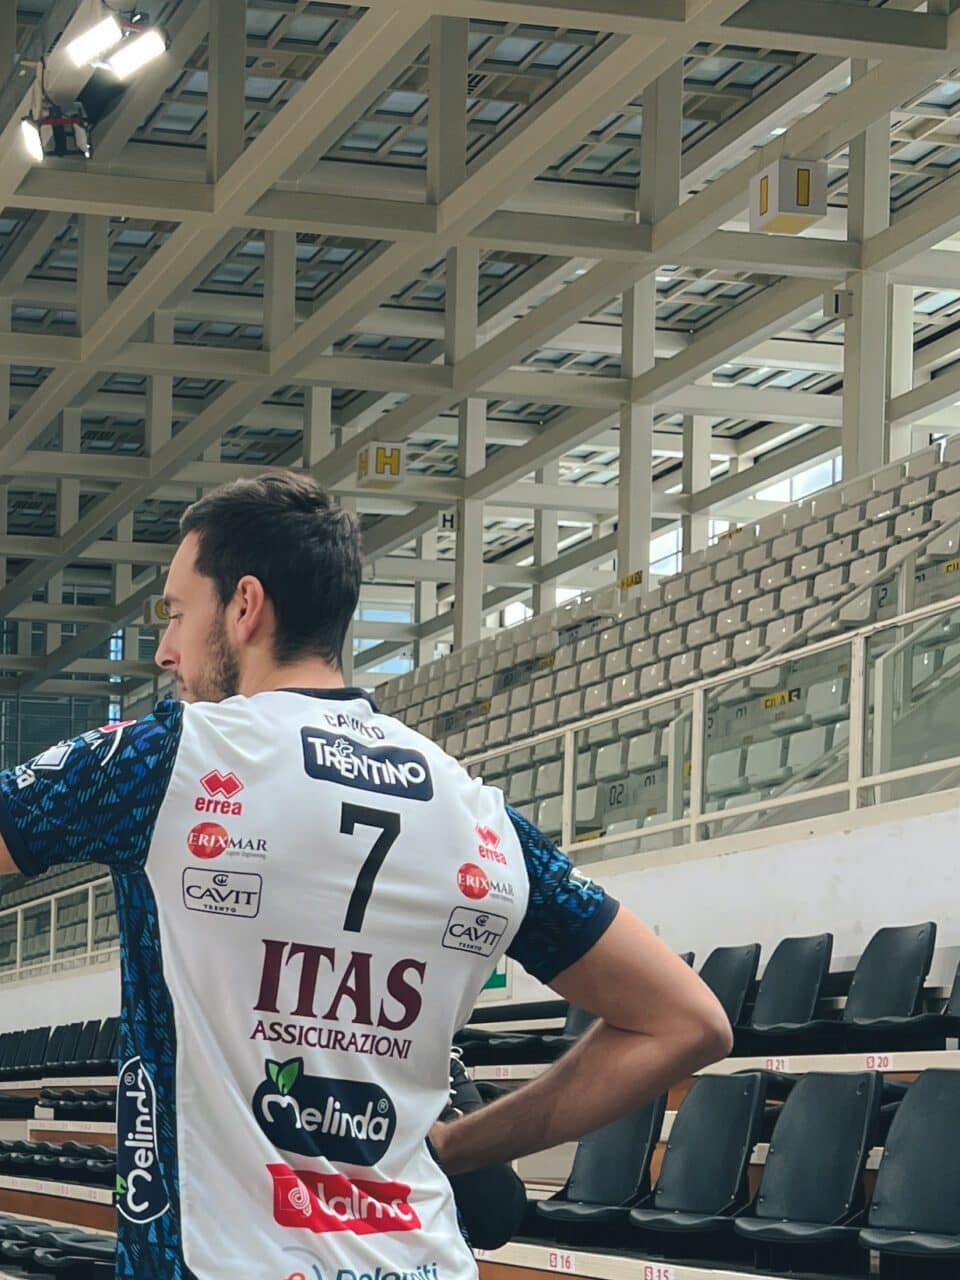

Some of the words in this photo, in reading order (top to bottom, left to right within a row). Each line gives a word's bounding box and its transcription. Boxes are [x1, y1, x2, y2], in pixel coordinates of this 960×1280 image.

[375, 446, 401, 476] H
[442, 513, 454, 529] H
[307, 737, 427, 788] TRENTINO
[194, 796, 243, 817] errea
[188, 831, 269, 852] ERIXMAR
[478, 844, 508, 866] errea
[339, 801, 401, 933] 7
[185, 884, 259, 906] CAVIT
[457, 872, 515, 897] ERIXMAR
[448, 923, 503, 946] CAVIT
[252, 938, 428, 1032] ITAS
[249, 1019, 413, 1060] ASSICURAZIONI
[877, 1056, 889, 1068] 20
[560, 1255, 571, 1270] 16
